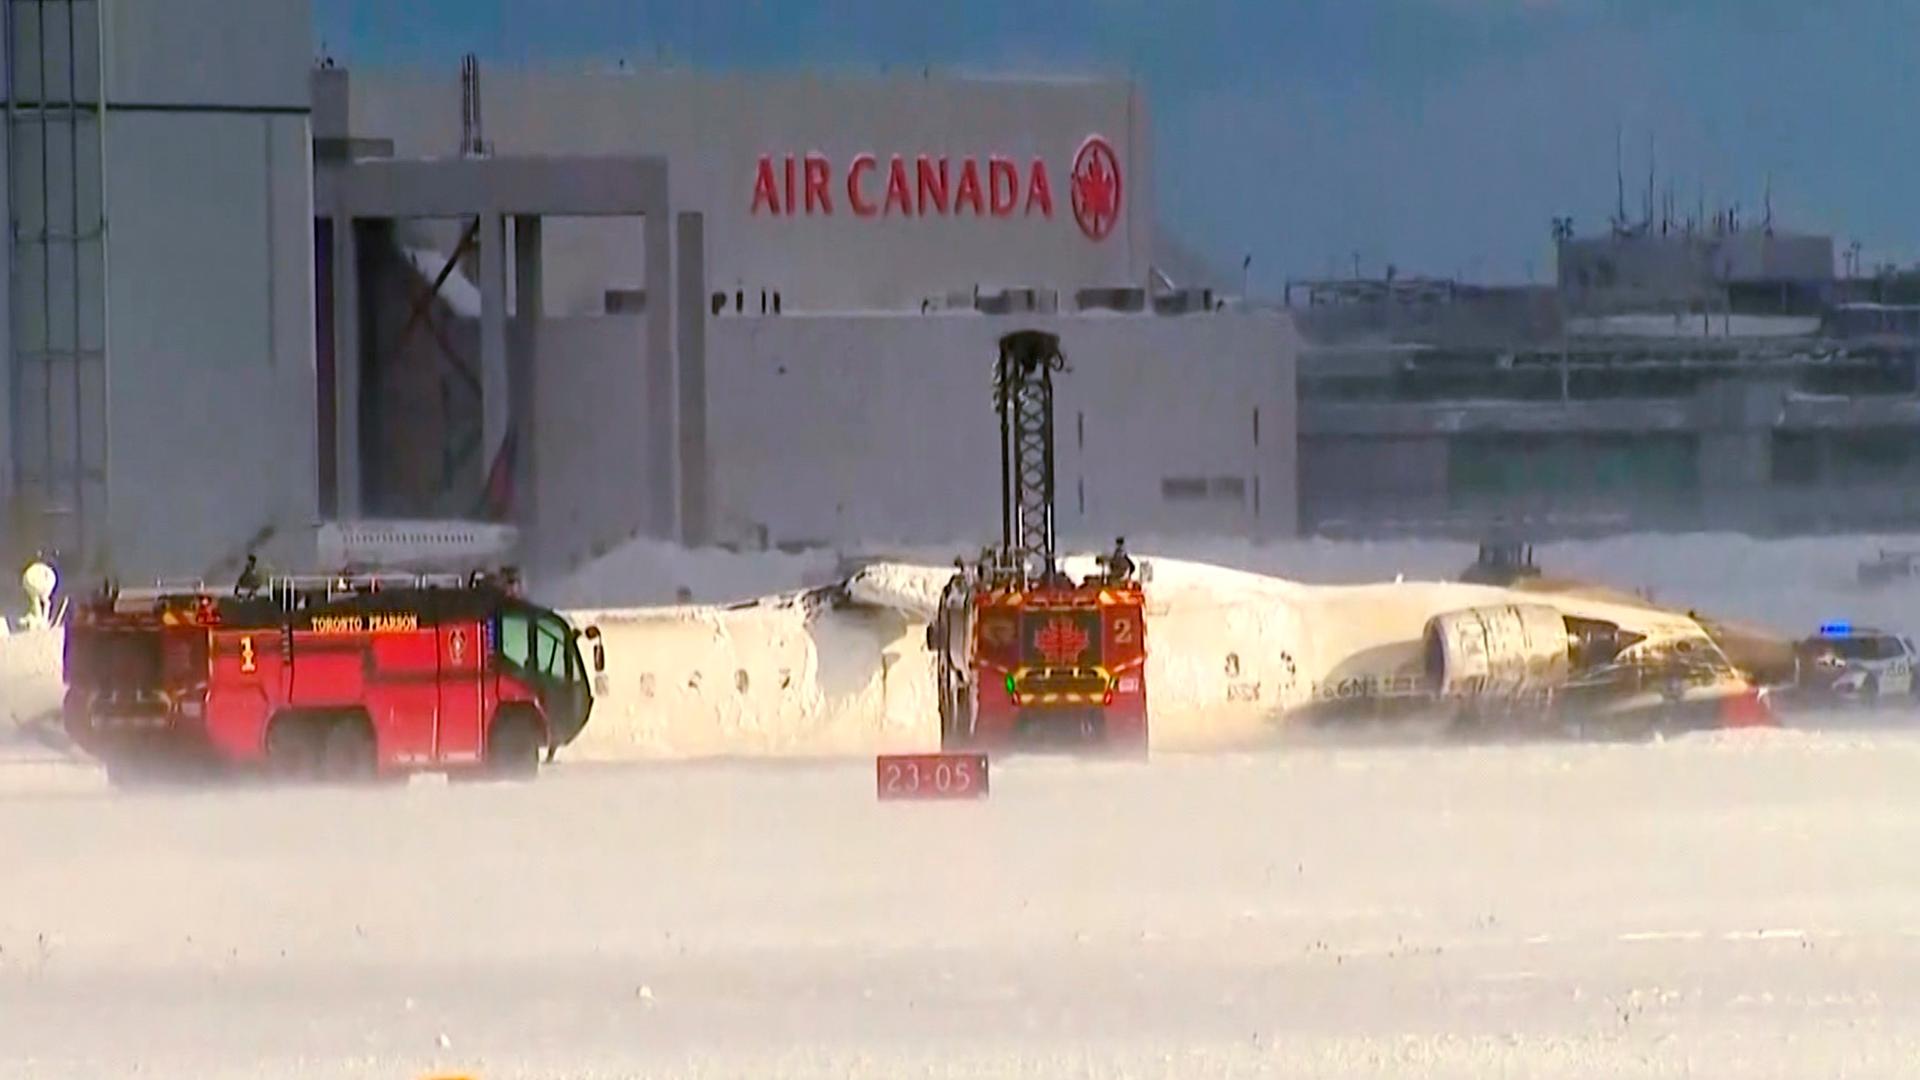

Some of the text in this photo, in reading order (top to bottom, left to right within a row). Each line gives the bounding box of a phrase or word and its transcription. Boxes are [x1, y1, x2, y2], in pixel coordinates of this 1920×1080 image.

[751, 153, 1053, 217] AIR CANADA
[311, 612, 418, 632] TORONTO PEARSON
[1114, 618, 1132, 643] 2
[241, 636, 256, 673] 1
[886, 763, 971, 792] 23-05
